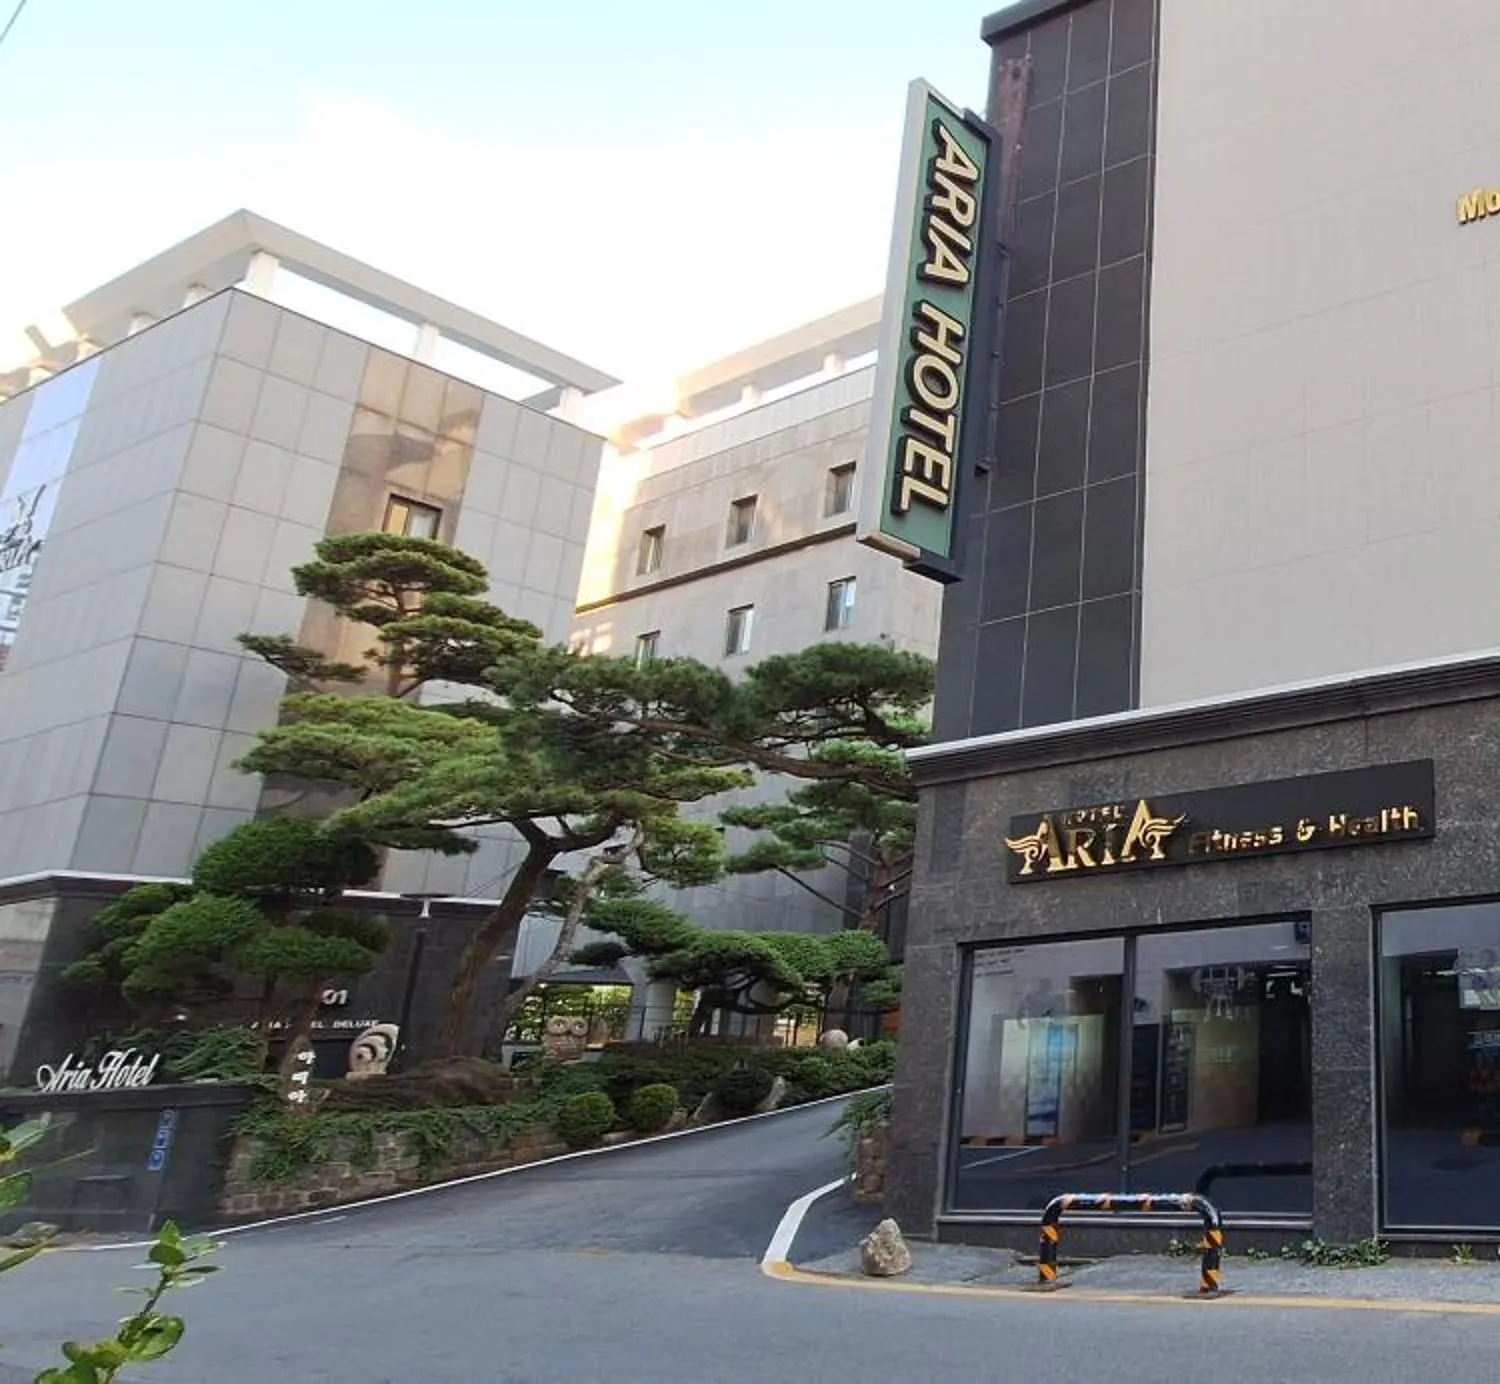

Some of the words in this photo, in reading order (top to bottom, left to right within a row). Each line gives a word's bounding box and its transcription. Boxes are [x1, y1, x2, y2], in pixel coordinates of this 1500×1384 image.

[919, 121, 980, 284] ARIA
[893, 301, 965, 514] HOTEL
[1004, 799, 1189, 875] ARIA
[1296, 817, 1316, 843] &
[36, 1052, 93, 1093] Aria
[89, 1047, 160, 1090] Hotel
